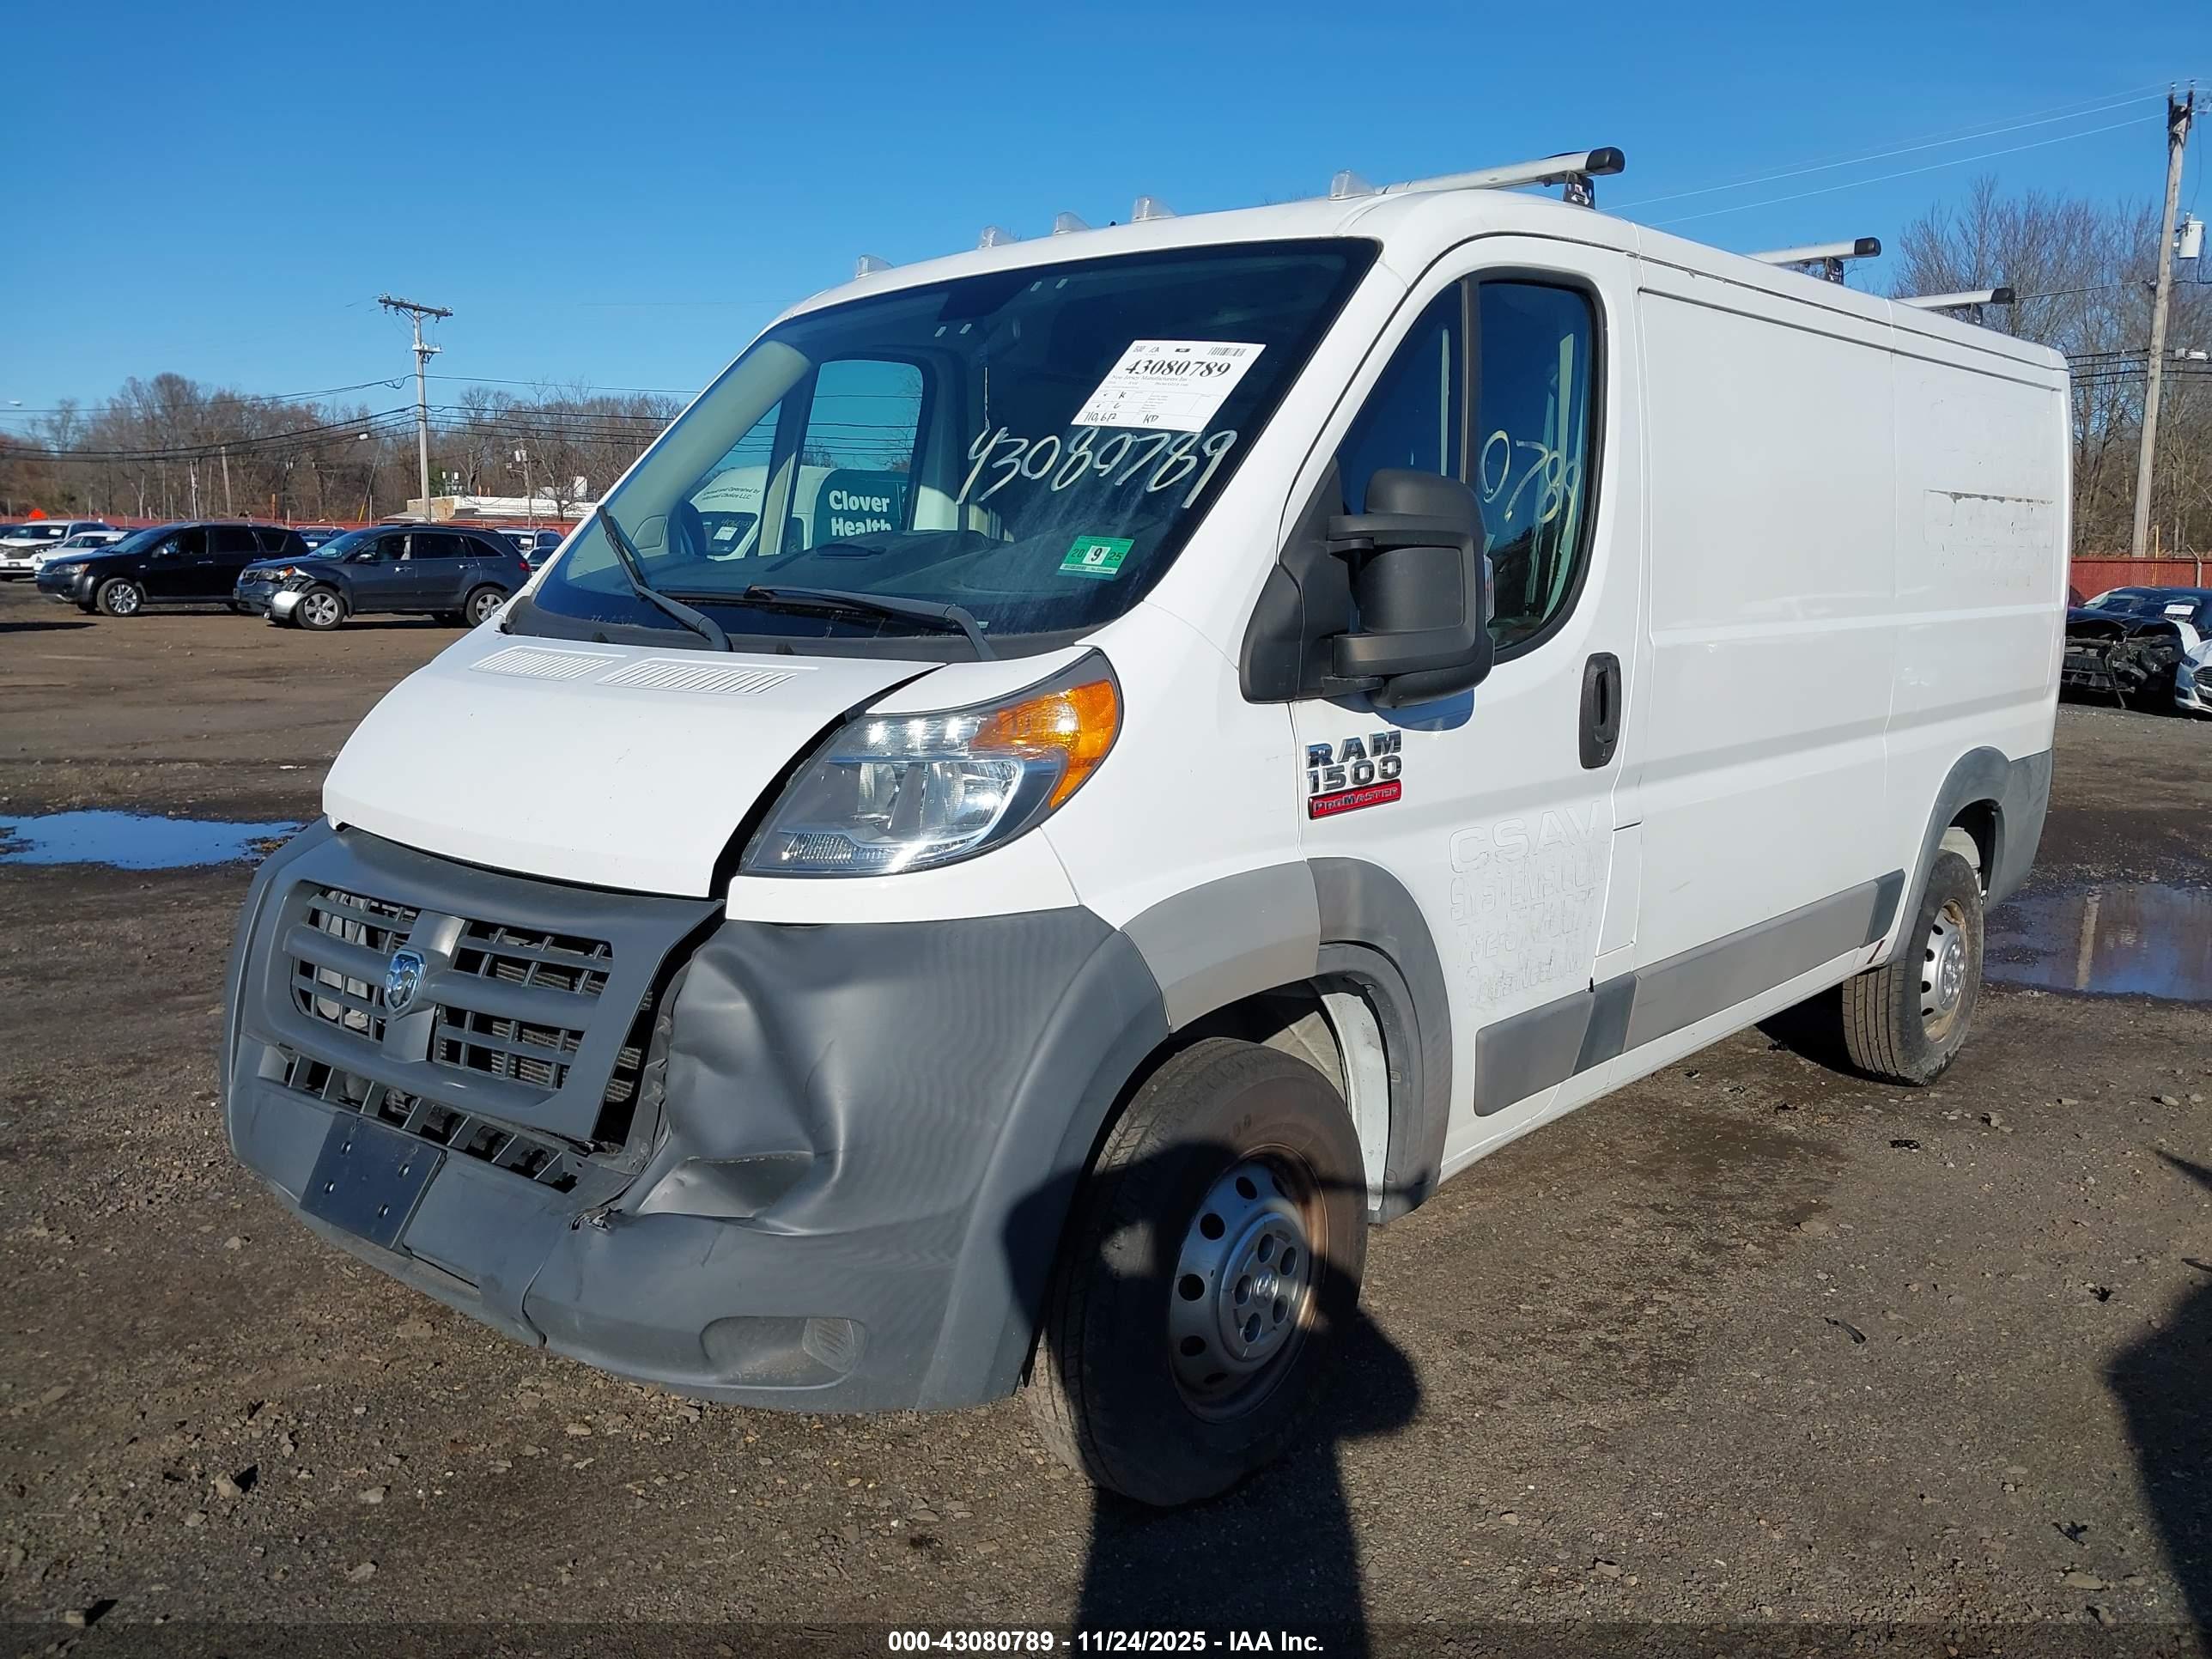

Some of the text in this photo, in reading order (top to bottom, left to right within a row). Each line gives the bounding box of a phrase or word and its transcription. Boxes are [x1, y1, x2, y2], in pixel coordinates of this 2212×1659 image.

[1125, 359, 1231, 377] 43080789
[829, 489, 890, 513] Clover
[830, 516, 892, 537] Health
[1072, 547, 1124, 562] 20 9 25
[1304, 729, 1402, 769] RAM
[1306, 755, 1402, 794] 1500
